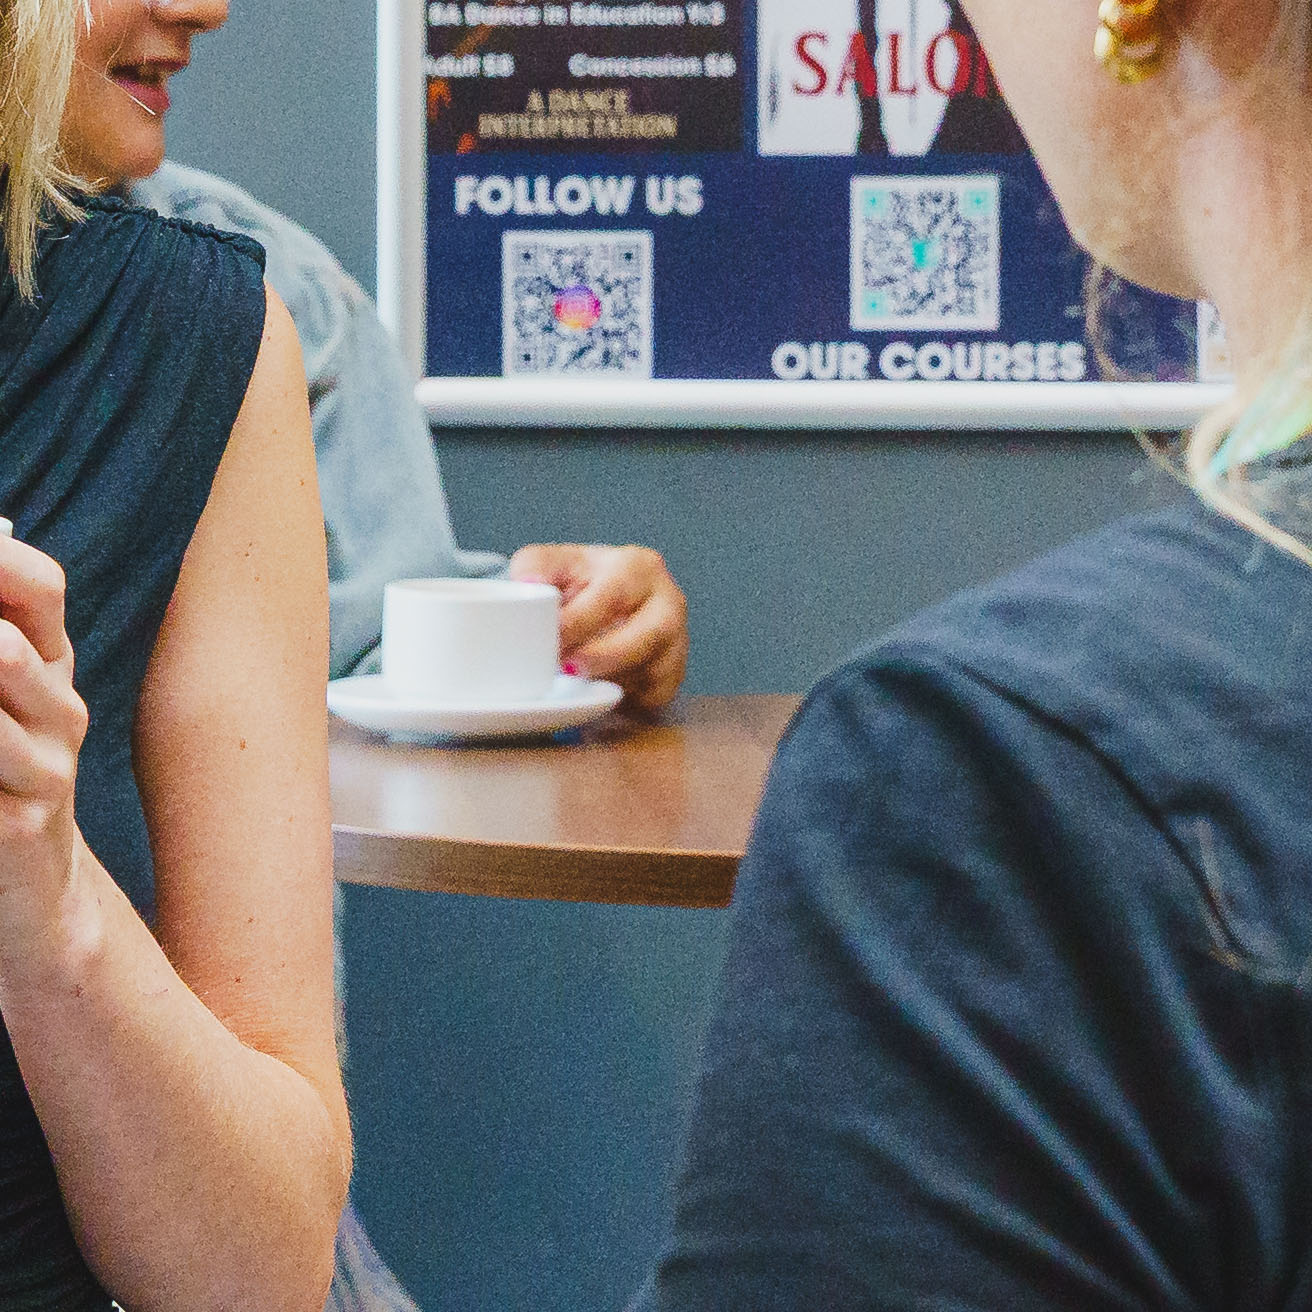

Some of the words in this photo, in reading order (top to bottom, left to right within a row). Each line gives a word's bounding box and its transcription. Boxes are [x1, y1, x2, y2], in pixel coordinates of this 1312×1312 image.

[793, 29, 989, 98] SALO
[454, 175, 636, 216] FOLLOW
[644, 174, 704, 216] US
[770, 340, 871, 380] OUR
[879, 340, 1086, 380] COURSES
